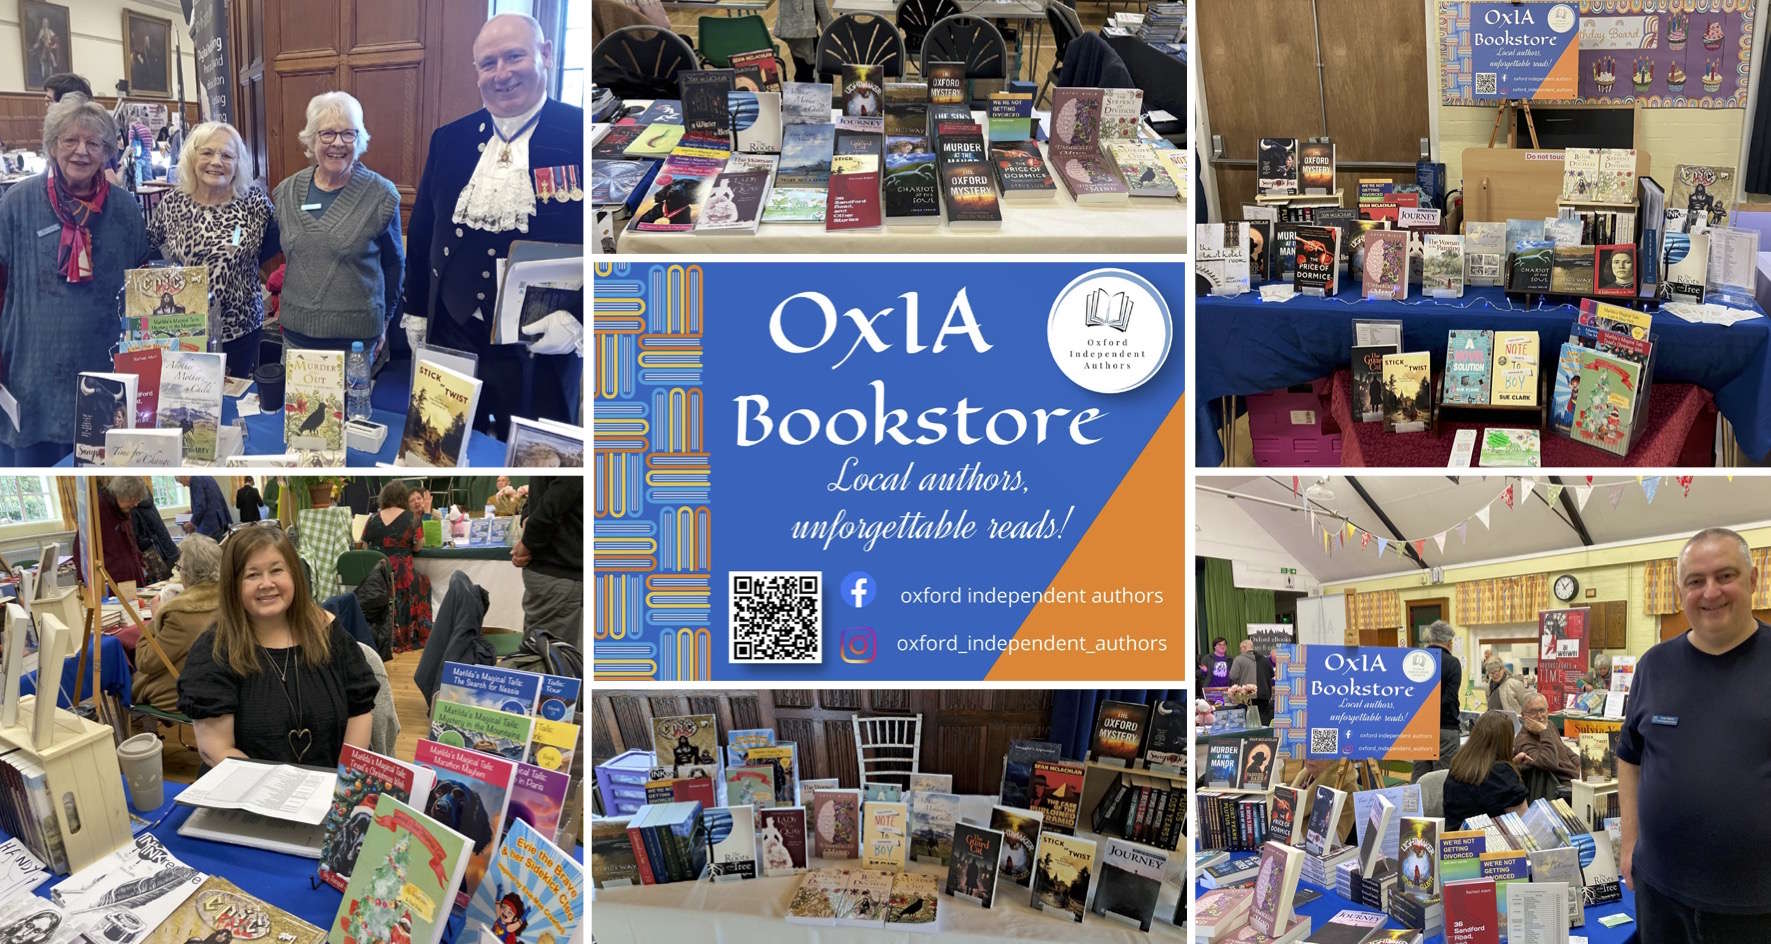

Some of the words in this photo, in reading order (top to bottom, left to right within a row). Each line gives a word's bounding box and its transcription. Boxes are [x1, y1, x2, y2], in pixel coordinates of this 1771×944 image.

[1475, 30, 1557, 46] Bookstore
[1497, 47, 1516, 56] Local
[933, 79, 960, 87] OXFORD
[931, 88, 961, 97] MYSTERY
[943, 143, 982, 152] MURDER
[1304, 157, 1329, 165] OXFORD
[1527, 152, 1535, 160] Do
[1537, 152, 1547, 160] not
[1303, 166, 1331, 174] MYSTERY
[951, 176, 988, 185] OXFORD
[950, 186, 992, 196] MYSTERY
[1401, 210, 1437, 221] JOURNEY
[1299, 263, 1319, 272] PRICE
[1319, 264, 1329, 272] OF
[1296, 272, 1331, 280] DORMICE
[1684, 284, 1700, 294] Tree
[1465, 338, 1475, 350] A
[1506, 344, 1528, 355] NOTE
[1069, 350, 1145, 359] Independent
[293, 359, 337, 372] MURDER
[419, 365, 442, 381] STICK
[303, 374, 327, 385] OUT
[1504, 376, 1525, 389] BOY
[445, 387, 469, 405] TWIST
[731, 379, 1111, 448] Bookstore
[826, 456, 915, 493] Local
[918, 461, 1029, 494] authors,
[791, 507, 978, 553] unforgettable
[987, 504, 1076, 542] reads!
[900, 586, 962, 605] oxford
[967, 586, 1087, 608] independent
[1091, 587, 1164, 605] authors
[896, 634, 1168, 656] oxford_independent_authors
[454, 676, 465, 684] The
[1311, 678, 1416, 697] Bookstore
[1338, 698, 1362, 709] Local
[1364, 700, 1394, 710] authors,
[1330, 712, 1382, 724] unforgettable
[1384, 712, 1409, 722] reads!
[1104, 718, 1138, 732] OXFORD
[1098, 729, 1139, 743] MYSTERY
[1210, 746, 1239, 754] MURDER
[1210, 760, 1235, 769] MANOR
[1043, 836, 1064, 847] STICK
[1069, 850, 1091, 861] TWIST
[1110, 845, 1163, 870] JOURNEY
[516, 837, 537, 856] Evie
[538, 850, 553, 868] the
[554, 864, 578, 899] Brave
[734, 863, 752, 871] Tree
[525, 857, 560, 895] Sidekick
[1603, 884, 1617, 892] Tree
[1454, 925, 1485, 934] Sandford
